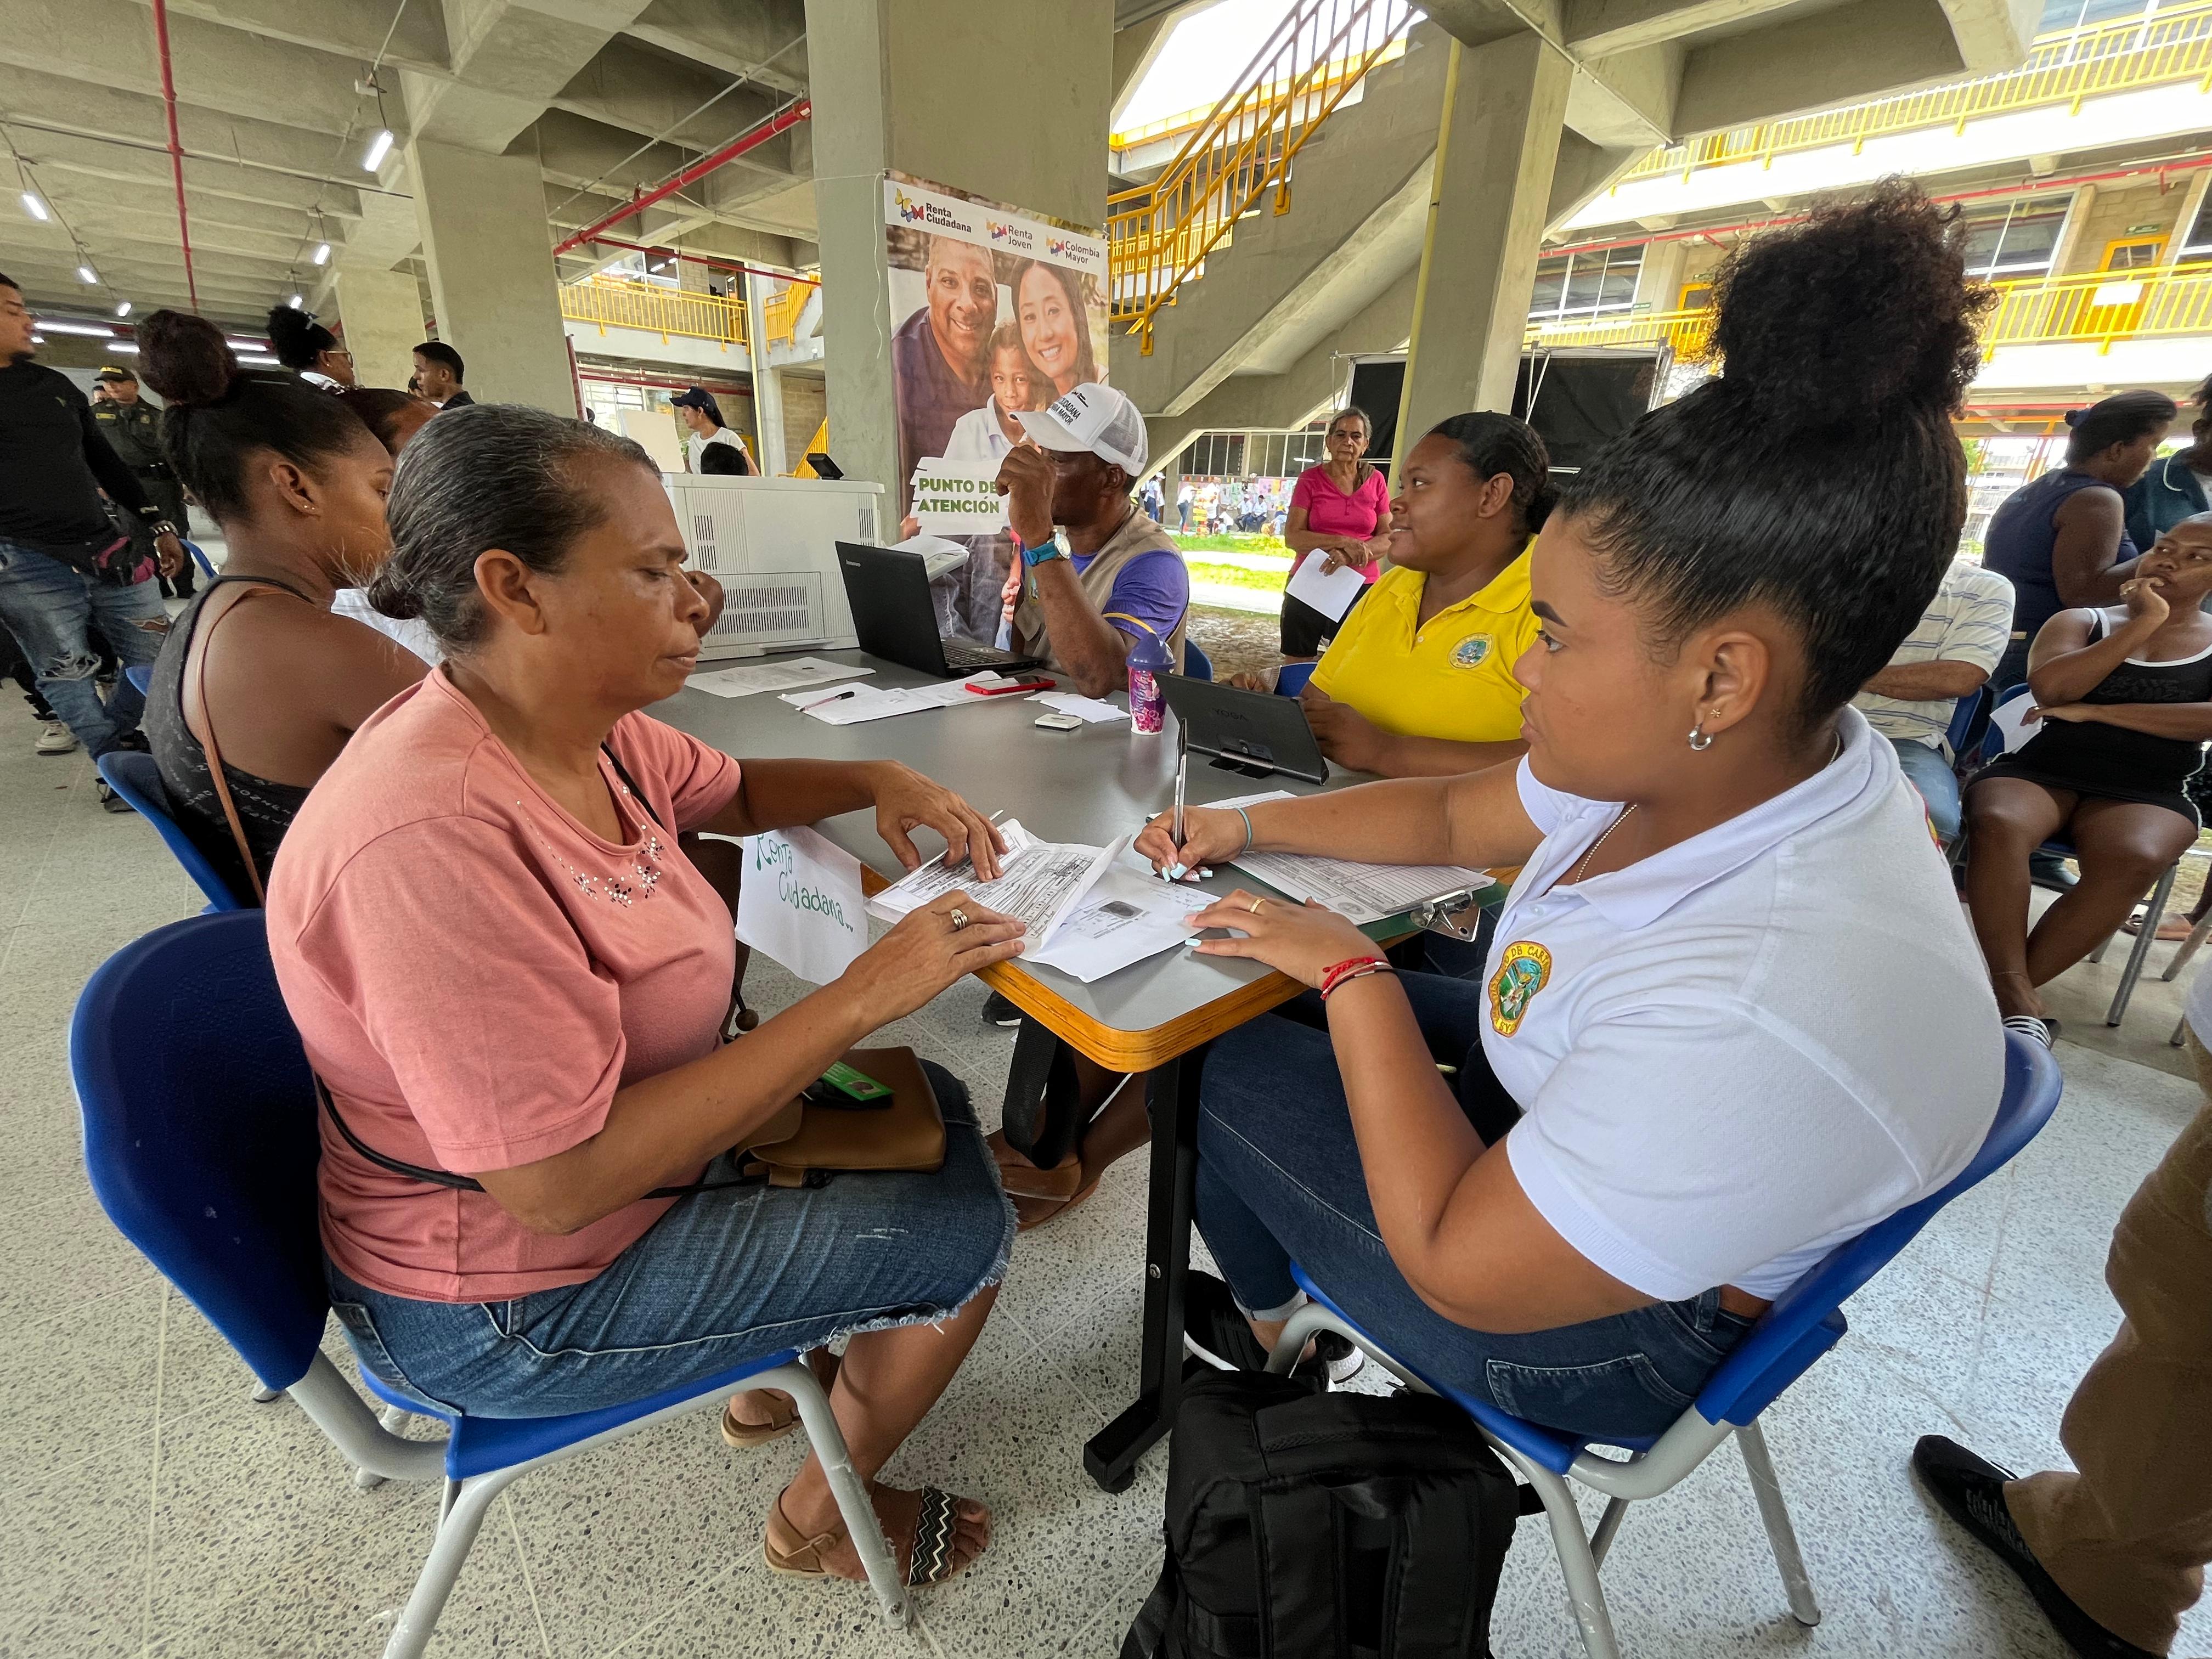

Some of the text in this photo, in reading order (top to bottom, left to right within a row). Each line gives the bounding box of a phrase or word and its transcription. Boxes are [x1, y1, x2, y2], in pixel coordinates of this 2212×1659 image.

[926, 202, 952, 218] Renta
[926, 213, 972, 233] Ciudadana
[1008, 224, 1032, 240] Renta
[1008, 235, 1032, 250] Joven
[1065, 241, 1100, 258] Colombia
[1065, 251, 1088, 264] Mayor
[918, 478, 997, 494] PUNTO DE
[917, 496, 1000, 514] ATENCIÓN
